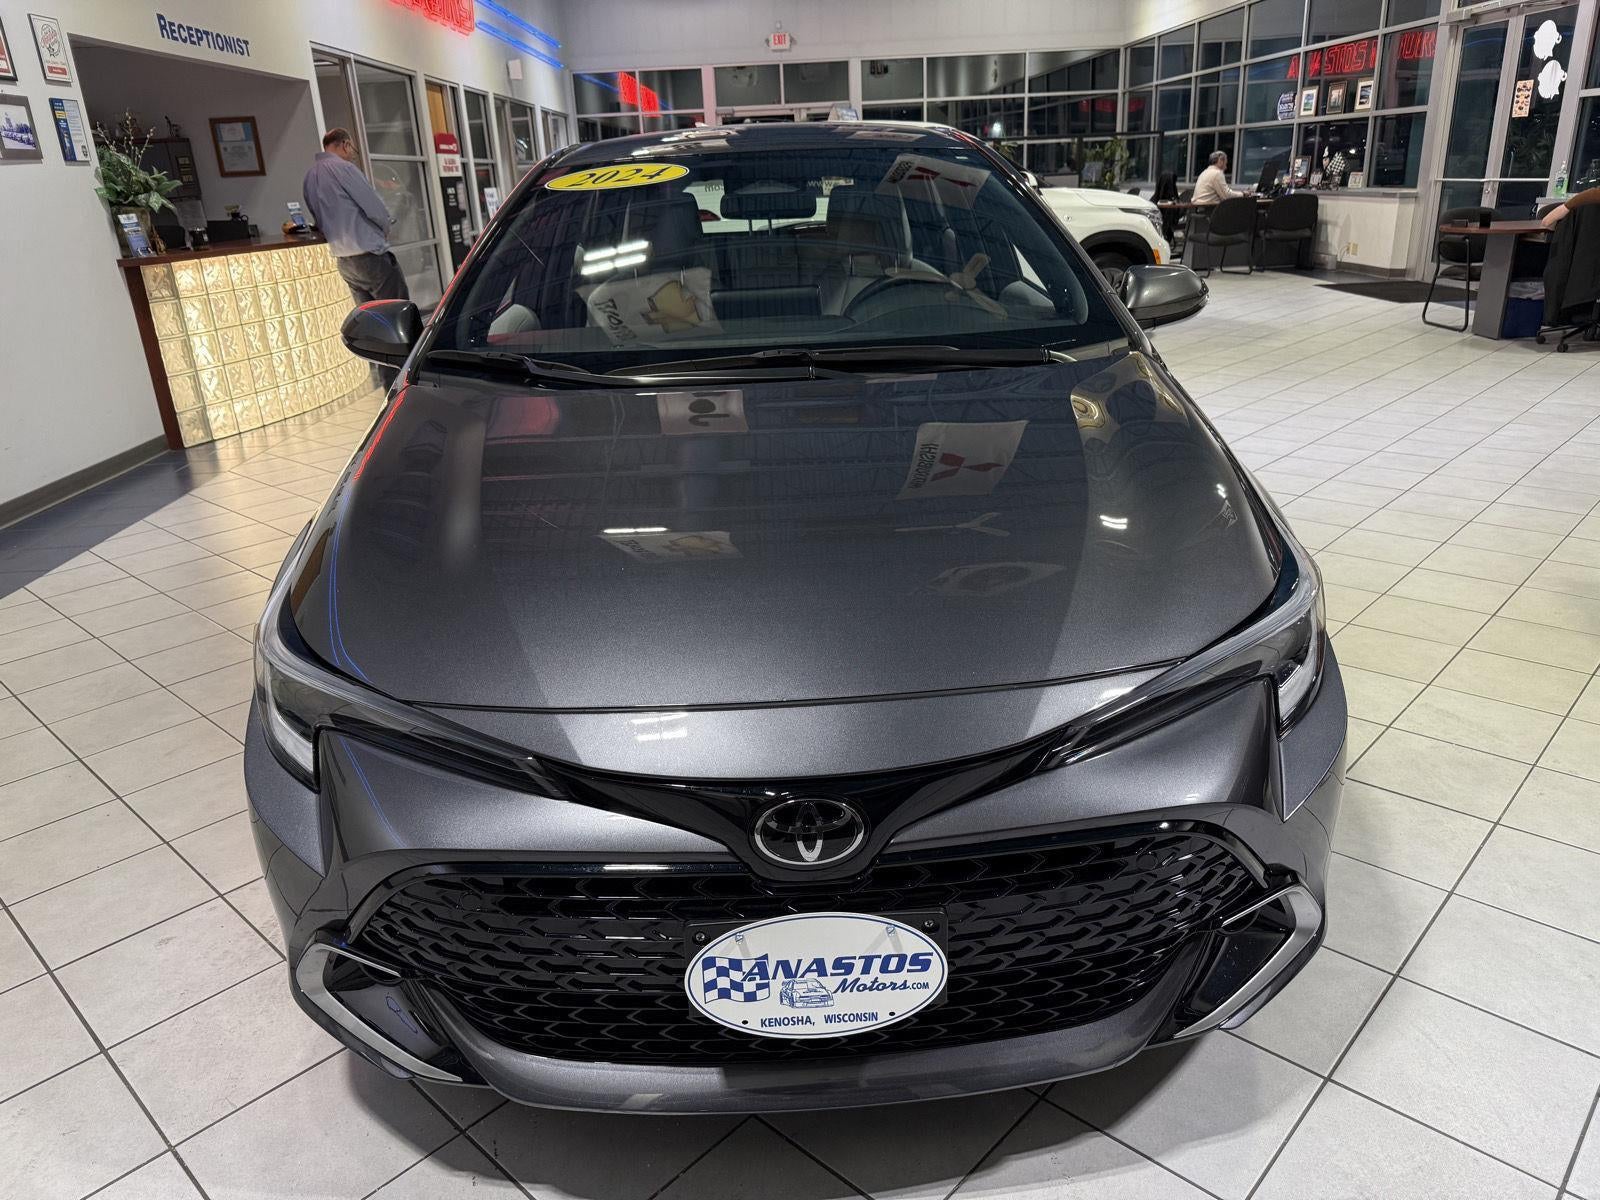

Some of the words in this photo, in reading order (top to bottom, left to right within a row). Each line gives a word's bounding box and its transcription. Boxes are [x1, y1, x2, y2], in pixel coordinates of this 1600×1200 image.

[156, 12, 251, 57] RECEPTIONIST
[772, 33, 788, 46] EXIT
[566, 165, 673, 188] 2024
[741, 952, 934, 982] ANASTOS
[760, 1015, 816, 1028] KENOSHA,
[824, 1011, 879, 1024] WISCONSIN
